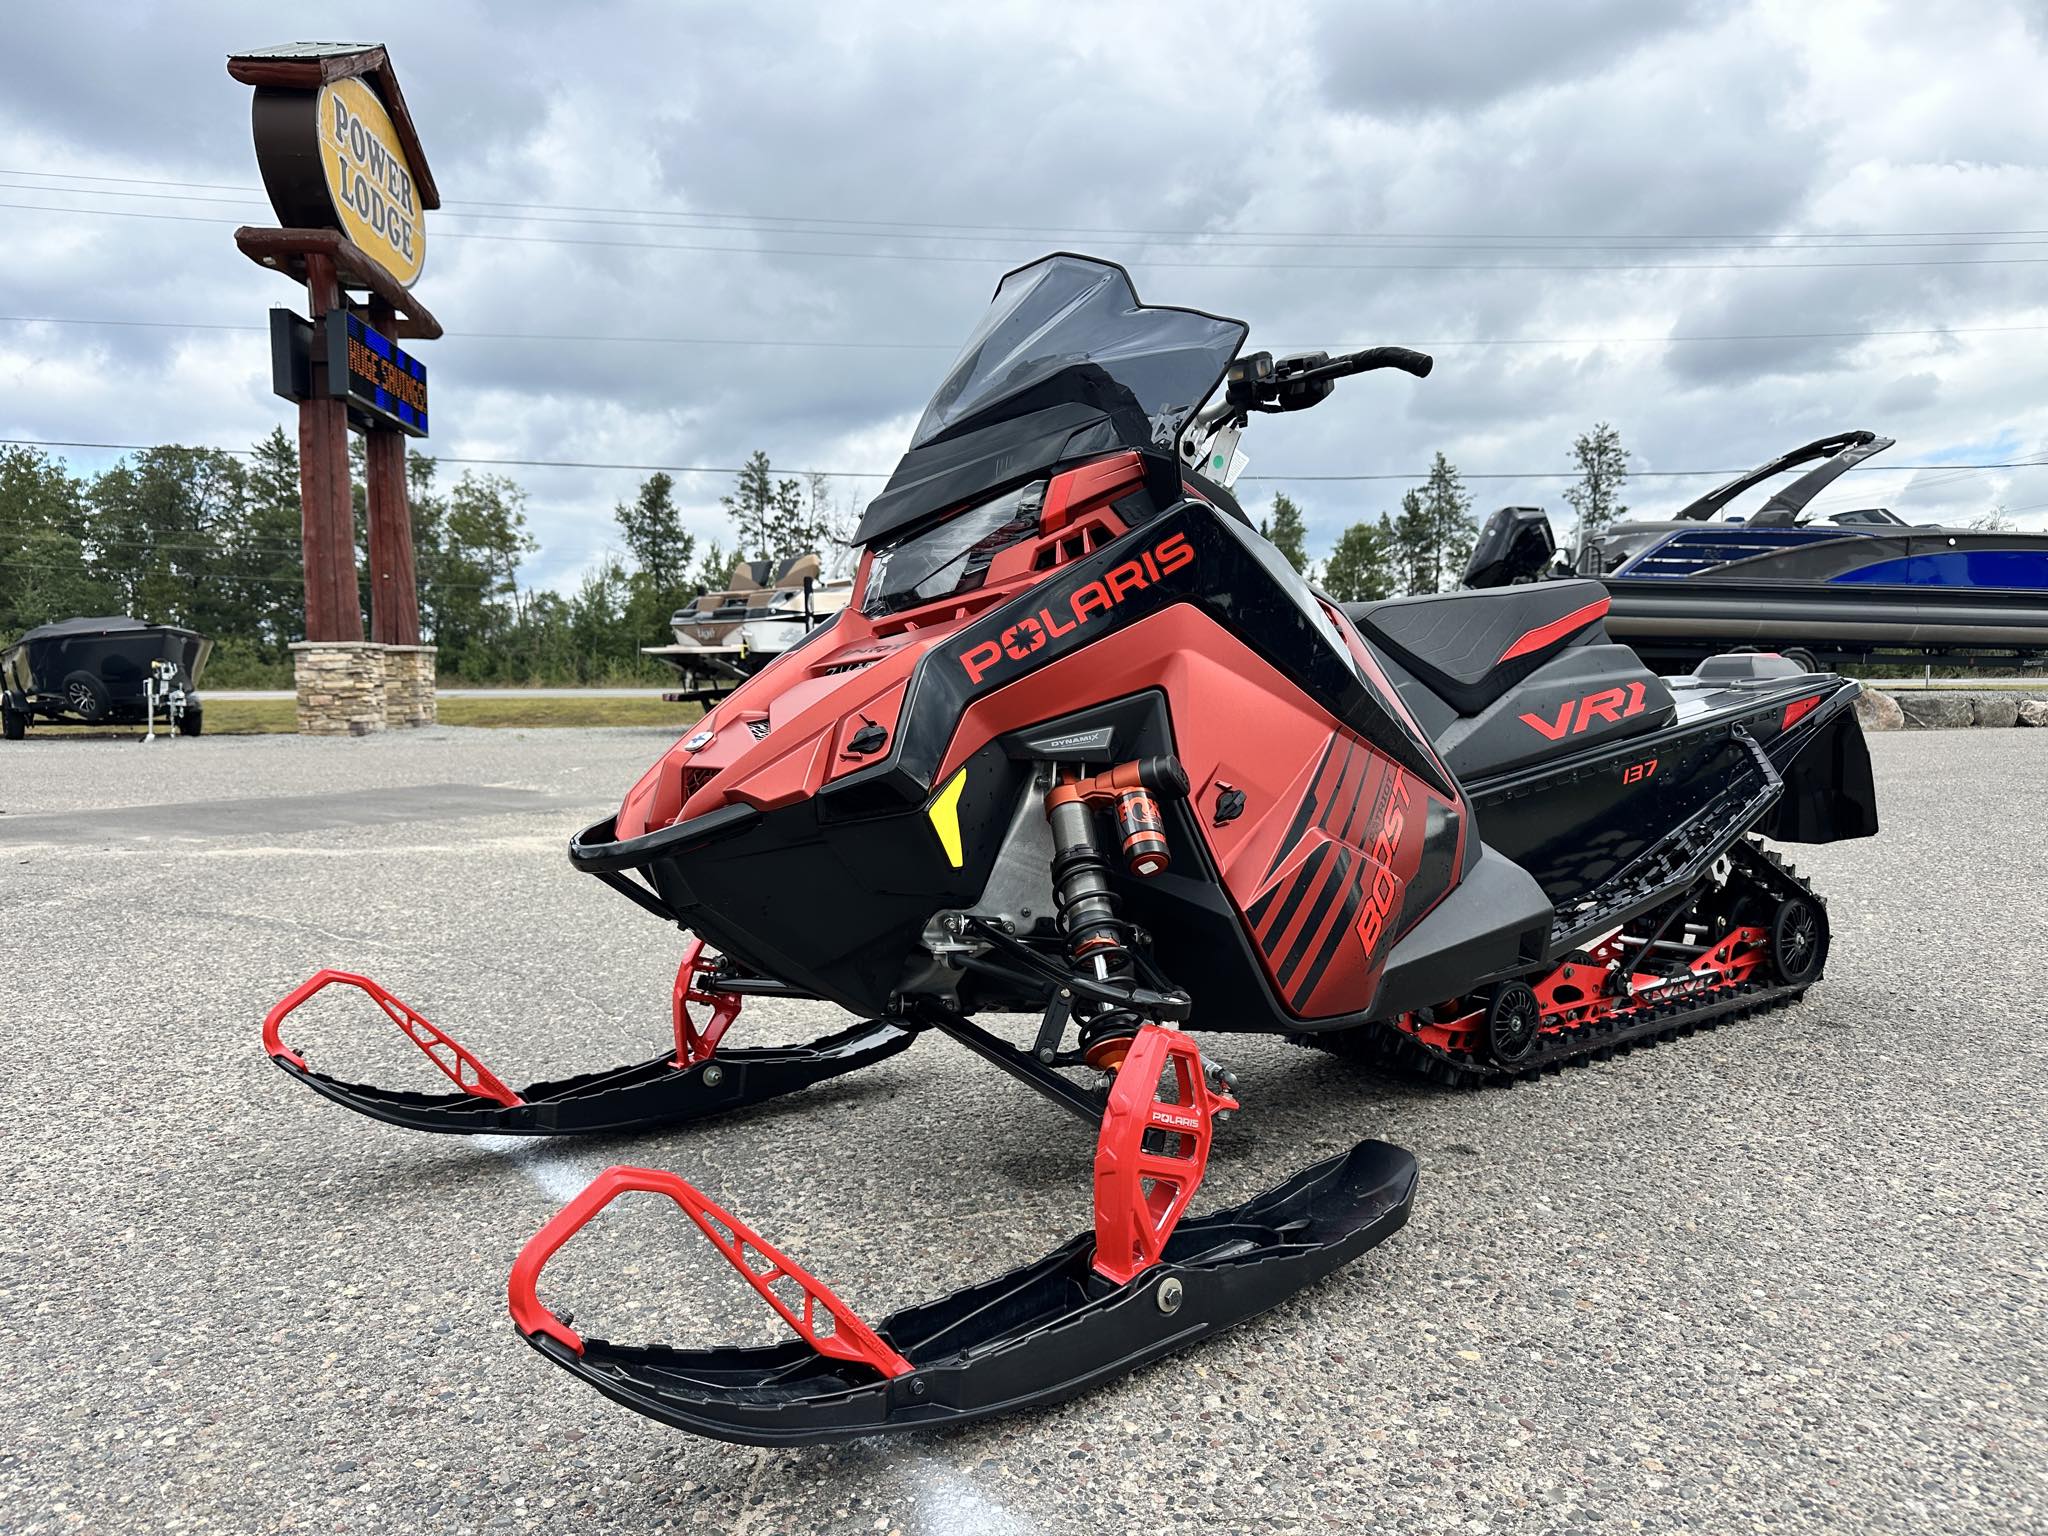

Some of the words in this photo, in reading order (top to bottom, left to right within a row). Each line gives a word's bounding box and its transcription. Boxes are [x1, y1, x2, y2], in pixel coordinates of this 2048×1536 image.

[333, 95, 414, 217] POWER
[339, 155, 413, 262] LODGE
[349, 336, 379, 385] HUGE
[959, 532, 1195, 685] POLARIS
[1051, 733, 1099, 747] DYNAMIX
[1518, 681, 1646, 740] VR1
[1623, 759, 1658, 785] 137
[1354, 766, 1411, 958] BOOST
[1152, 1111, 1199, 1128] POLARIS
